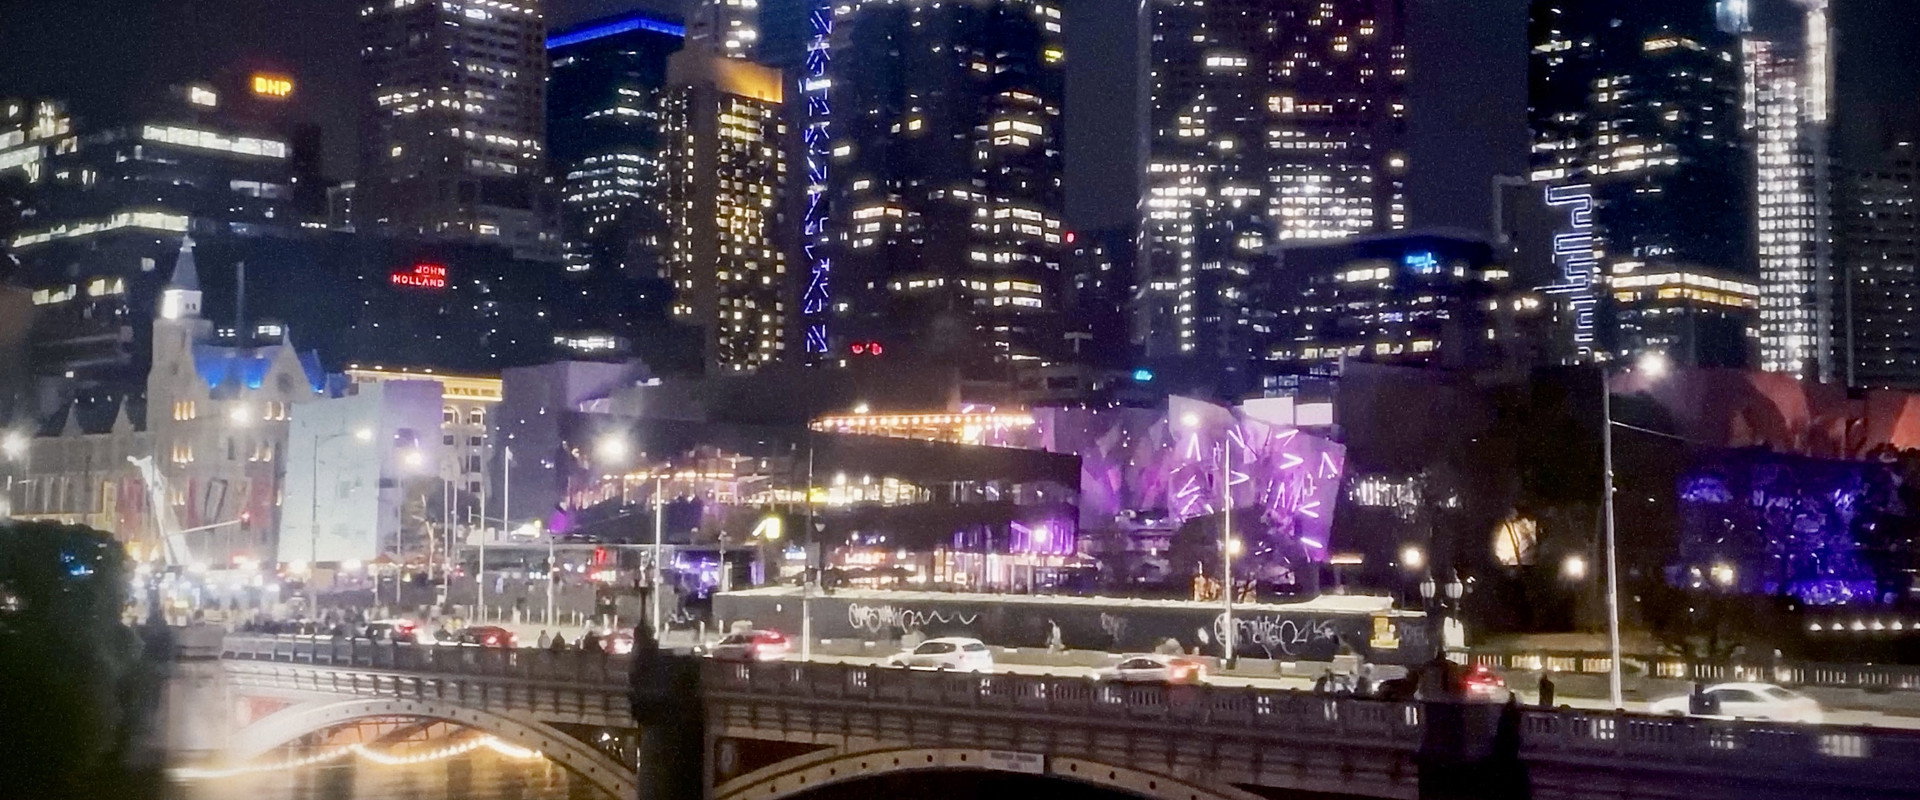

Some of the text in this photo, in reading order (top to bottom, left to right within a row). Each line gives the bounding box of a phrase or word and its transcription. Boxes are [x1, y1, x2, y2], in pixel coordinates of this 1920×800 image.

[255, 77, 291, 96] BHP
[415, 265, 446, 276] JOHN
[393, 274, 445, 288] HOLLAND
